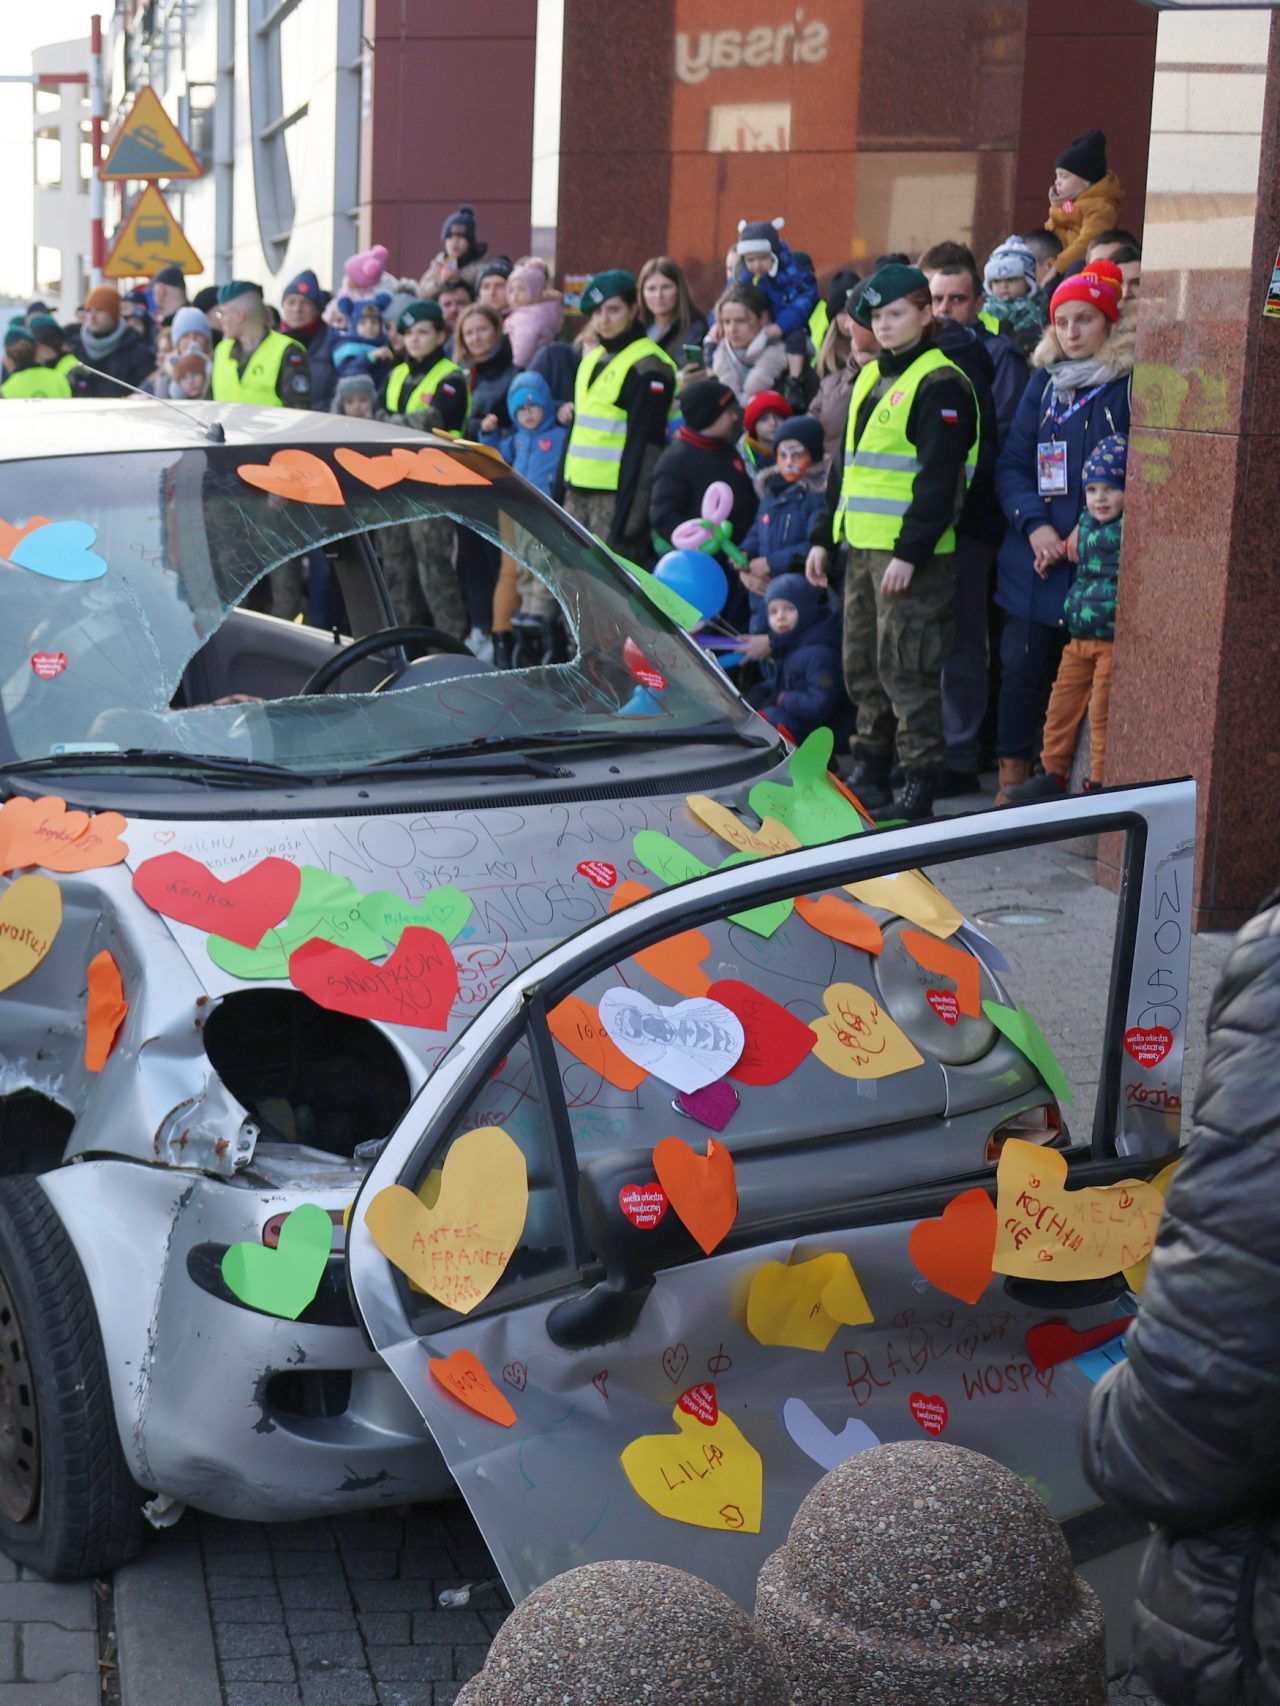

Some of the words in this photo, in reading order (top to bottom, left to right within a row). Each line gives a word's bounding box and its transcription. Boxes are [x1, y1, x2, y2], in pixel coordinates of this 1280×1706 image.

[623, 1192, 640, 1203] wielka
[641, 1191, 664, 1202] orkiestra
[636, 1215, 657, 1224] pomocy
[412, 1221, 481, 1250] ANTEK
[962, 1353, 1032, 1400] WOŚP
